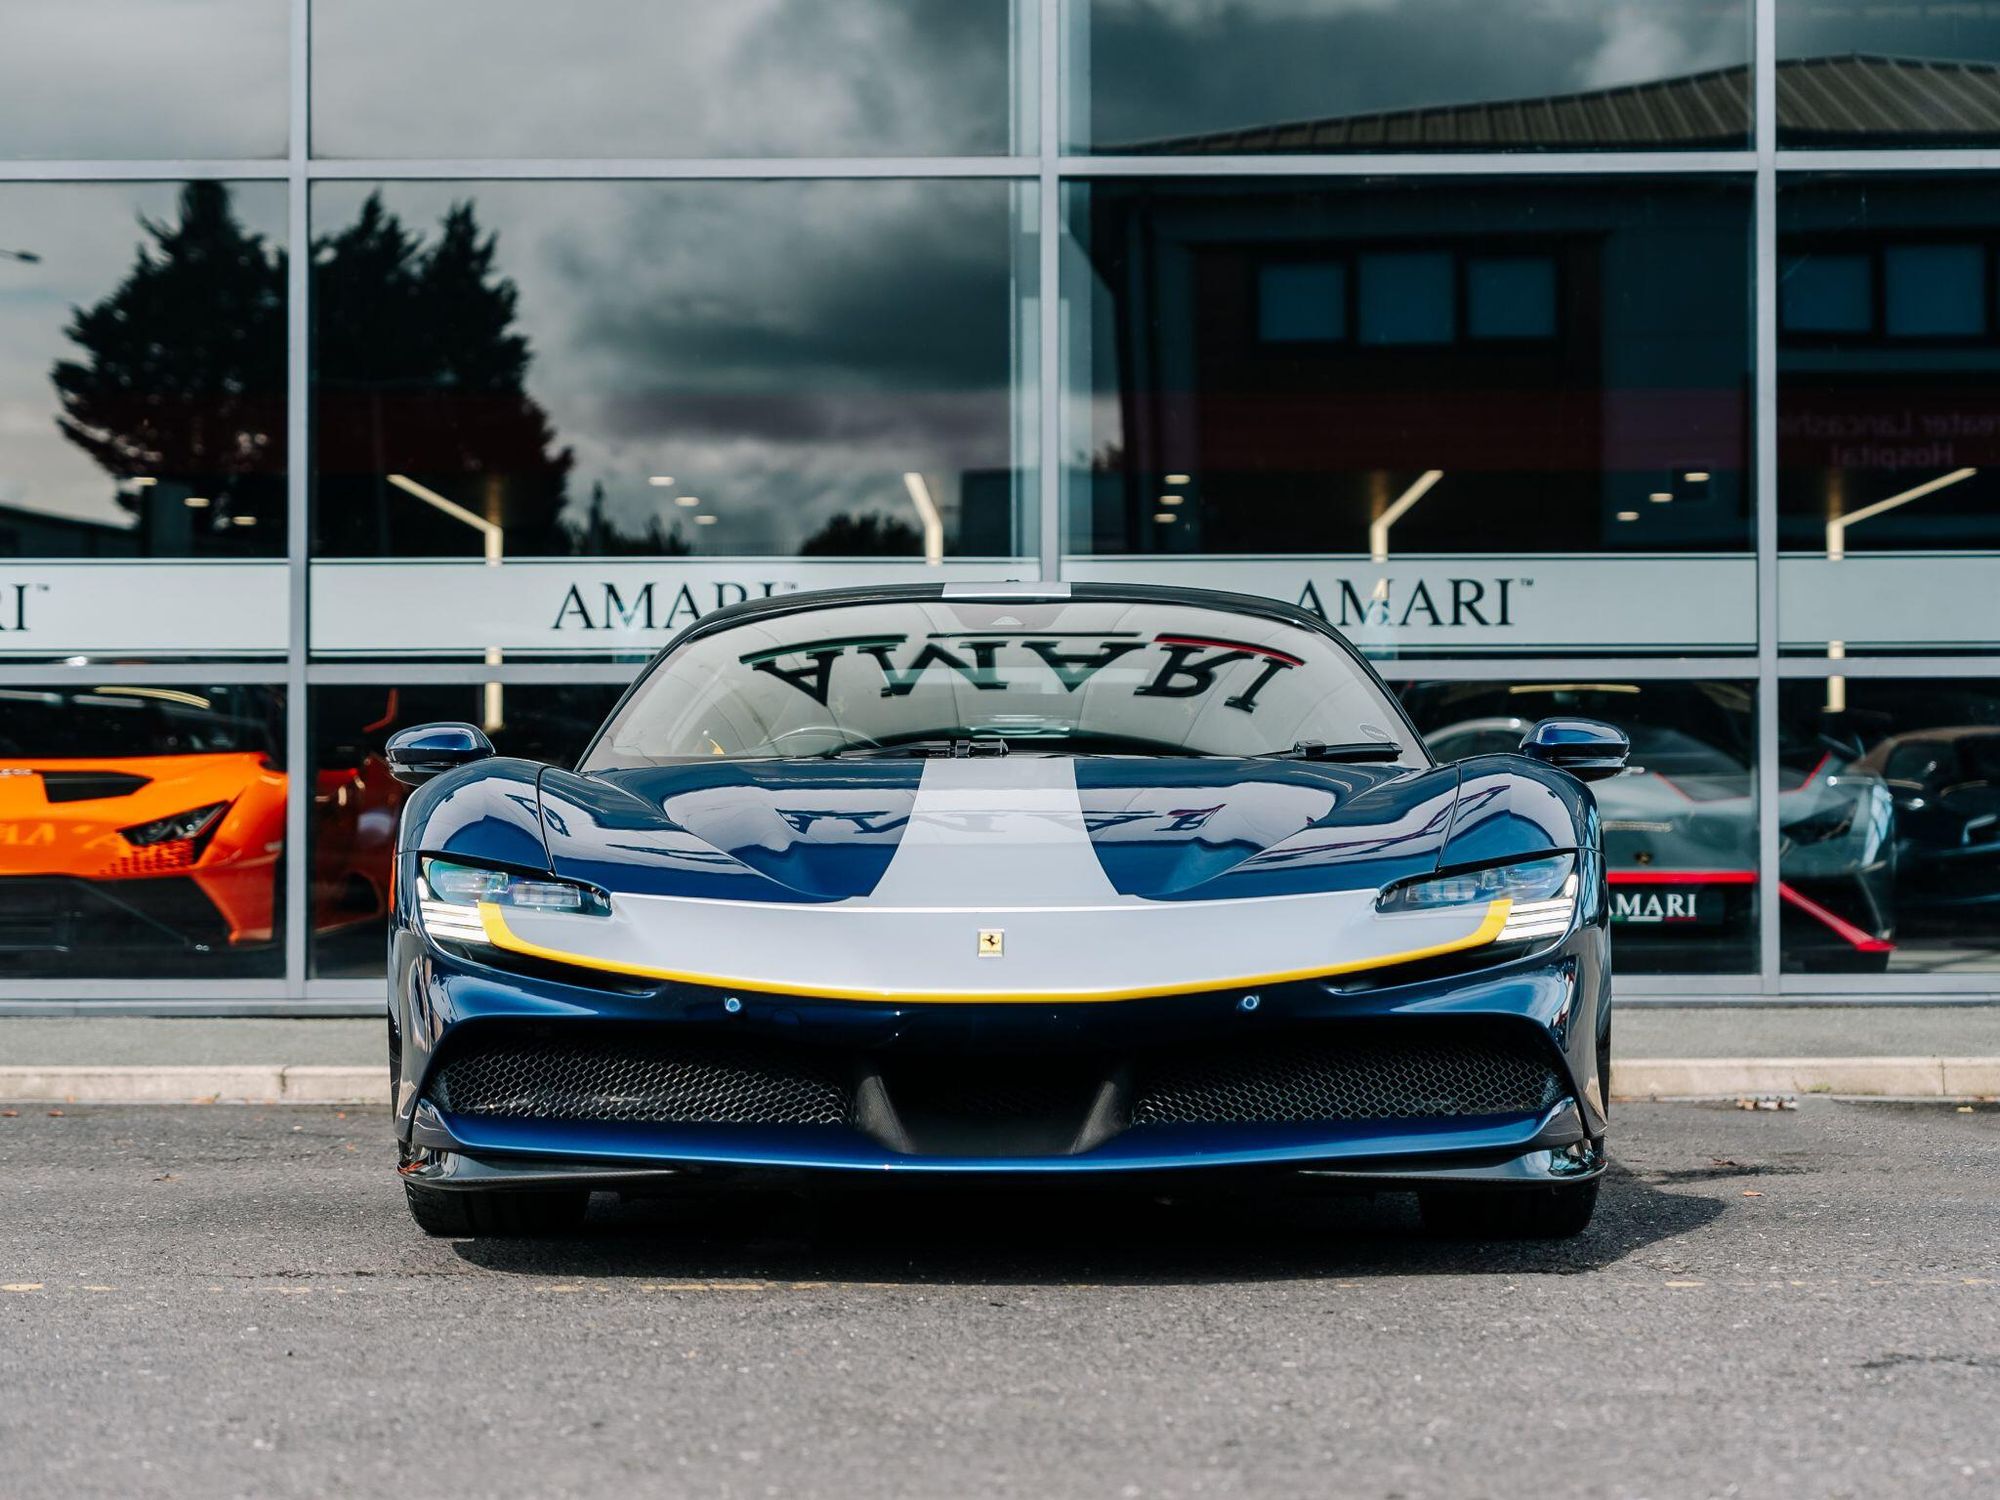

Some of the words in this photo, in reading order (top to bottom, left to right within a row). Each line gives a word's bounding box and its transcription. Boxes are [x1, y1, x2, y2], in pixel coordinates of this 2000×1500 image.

[0, 583, 31, 631] I
[1298, 578, 1514, 626] AMARI
[1608, 893, 1697, 917] MARI
